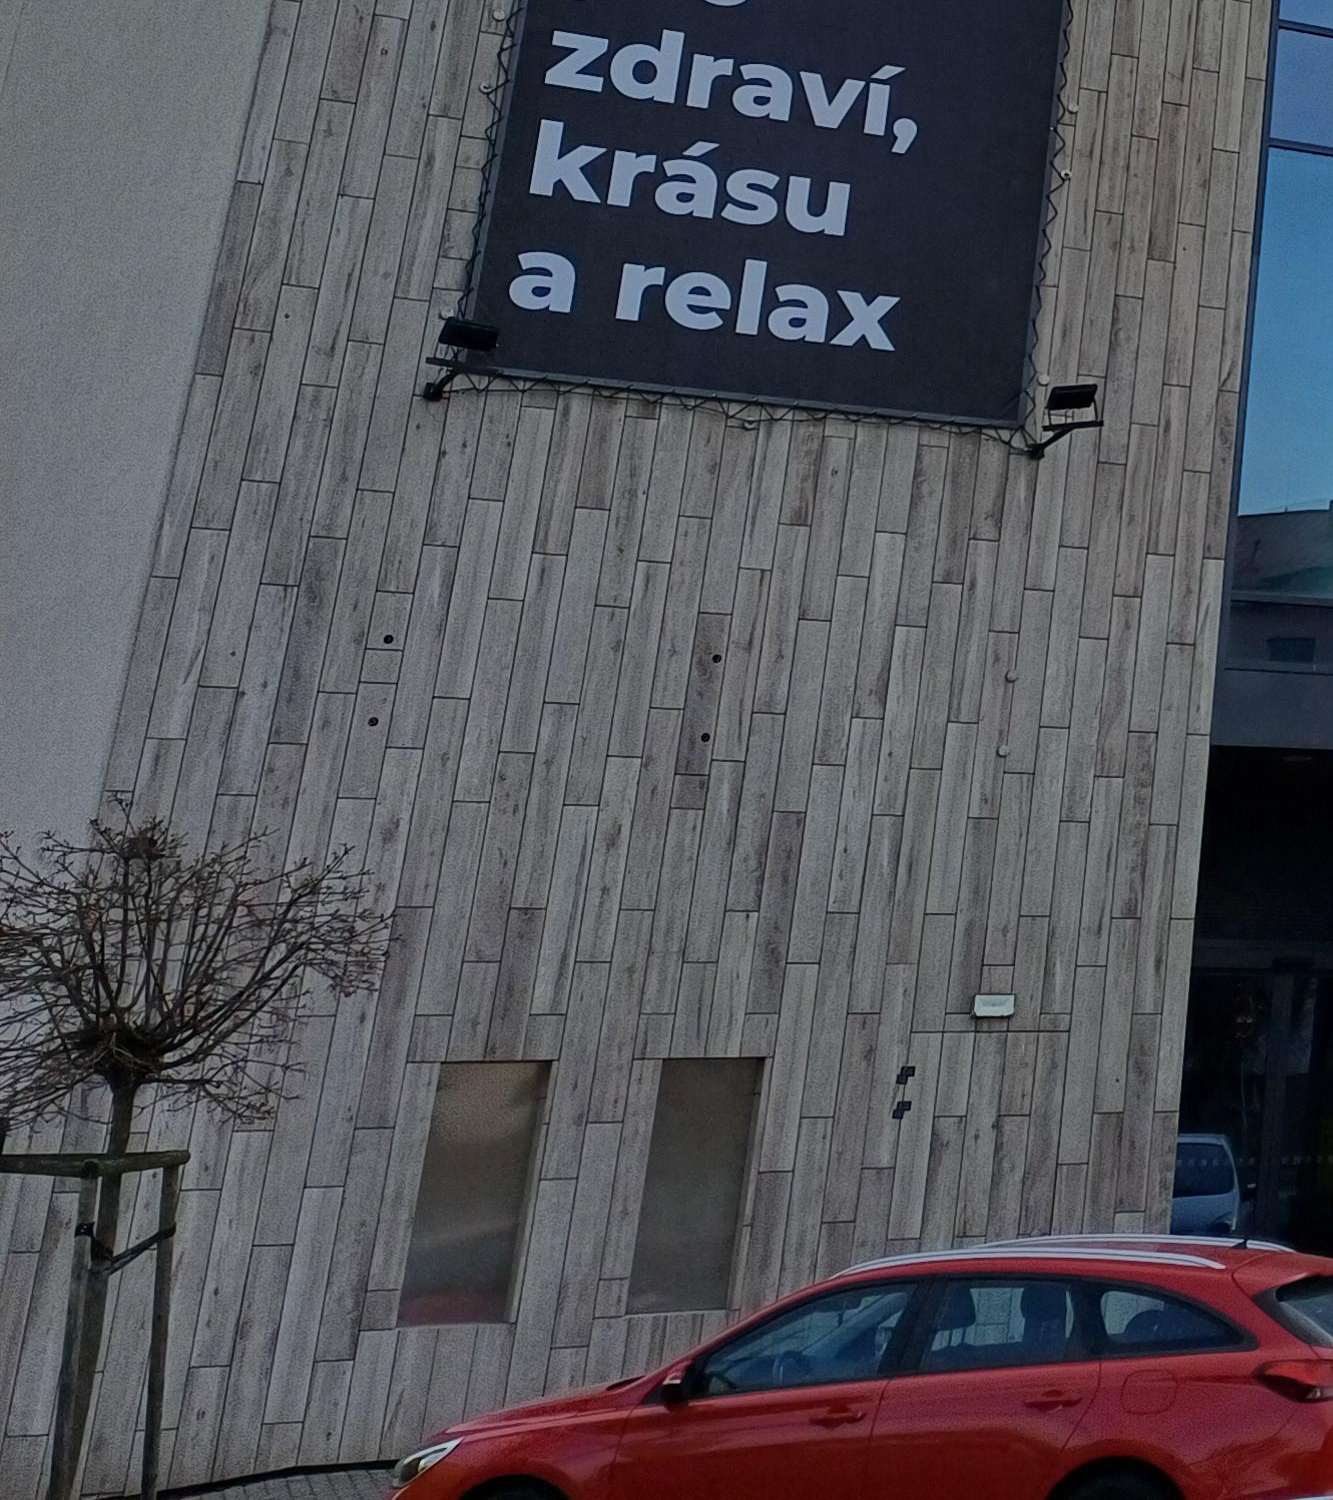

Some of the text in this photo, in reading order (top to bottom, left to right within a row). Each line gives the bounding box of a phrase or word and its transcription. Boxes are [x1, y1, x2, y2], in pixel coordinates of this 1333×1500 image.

[543, 29, 920, 155] zdraví,
[528, 119, 852, 237] krásu
[508, 250, 901, 352] a relax
